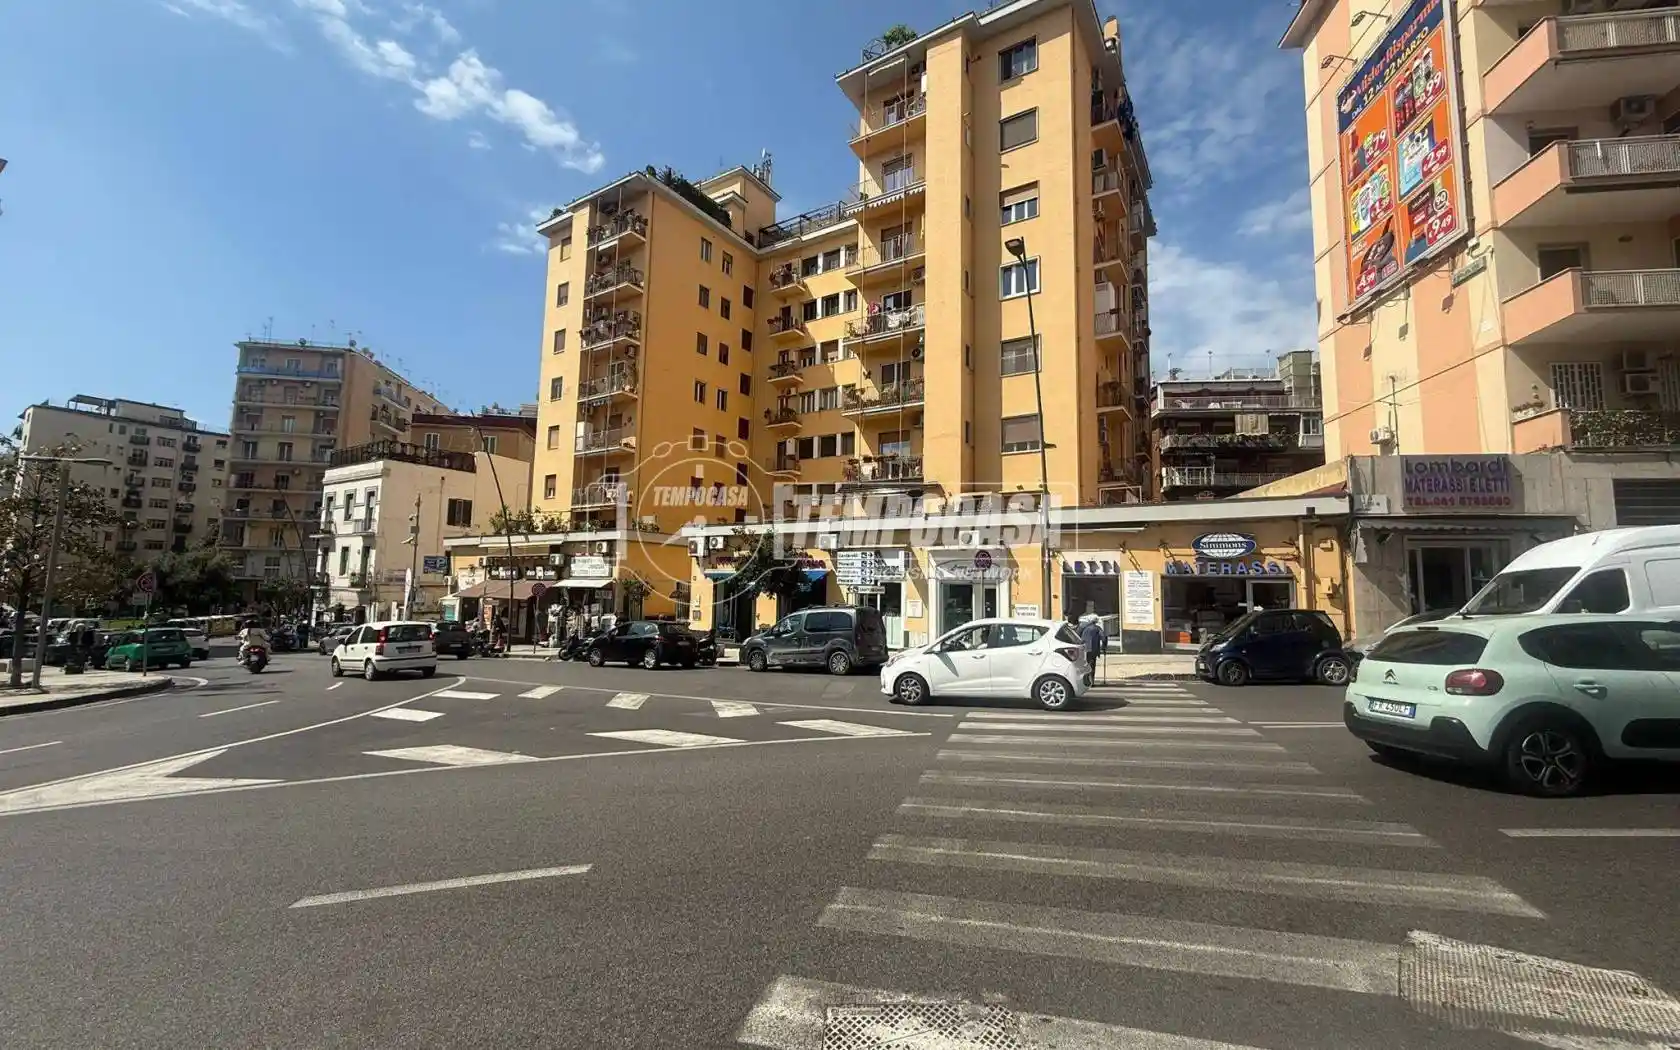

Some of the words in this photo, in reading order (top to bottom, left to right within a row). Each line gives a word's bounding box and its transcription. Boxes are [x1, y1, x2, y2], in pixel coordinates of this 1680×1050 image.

[1404, 457, 1507, 474] Lombardi
[1404, 478, 1467, 493] MATERASSI
[1200, 541, 1248, 550] Simmons
[1164, 561, 1288, 576] MATERASSI
